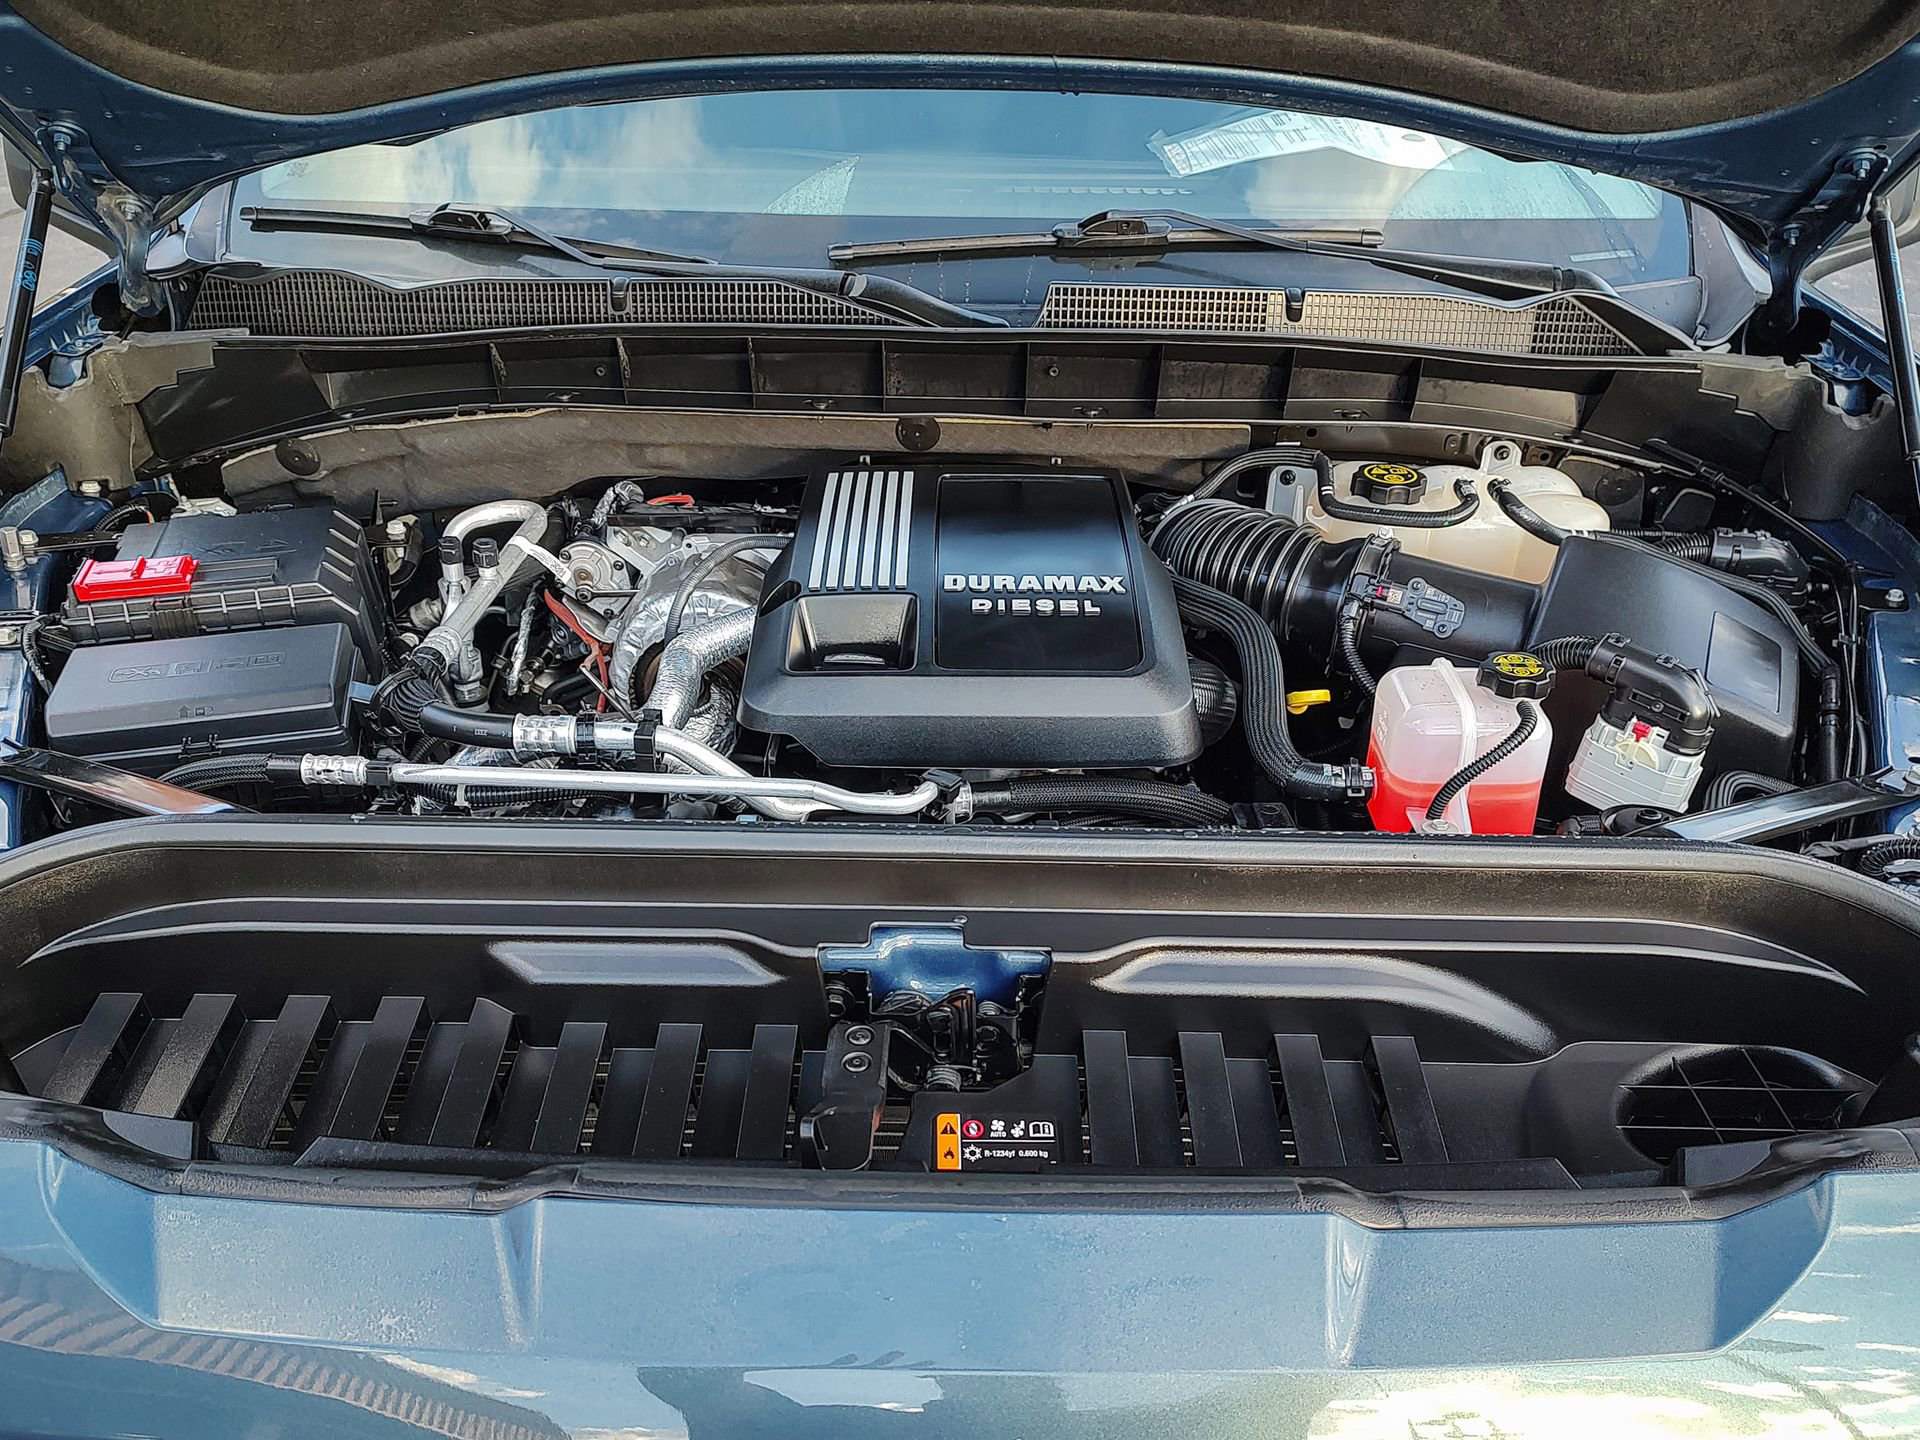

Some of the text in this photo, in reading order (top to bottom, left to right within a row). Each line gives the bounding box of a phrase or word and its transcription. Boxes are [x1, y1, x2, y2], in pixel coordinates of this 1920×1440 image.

[943, 575, 1126, 593] DURAMAX
[971, 598, 1101, 616] DIESEL
[984, 1149, 1049, 1159] R-1234yf 0.600 kg
